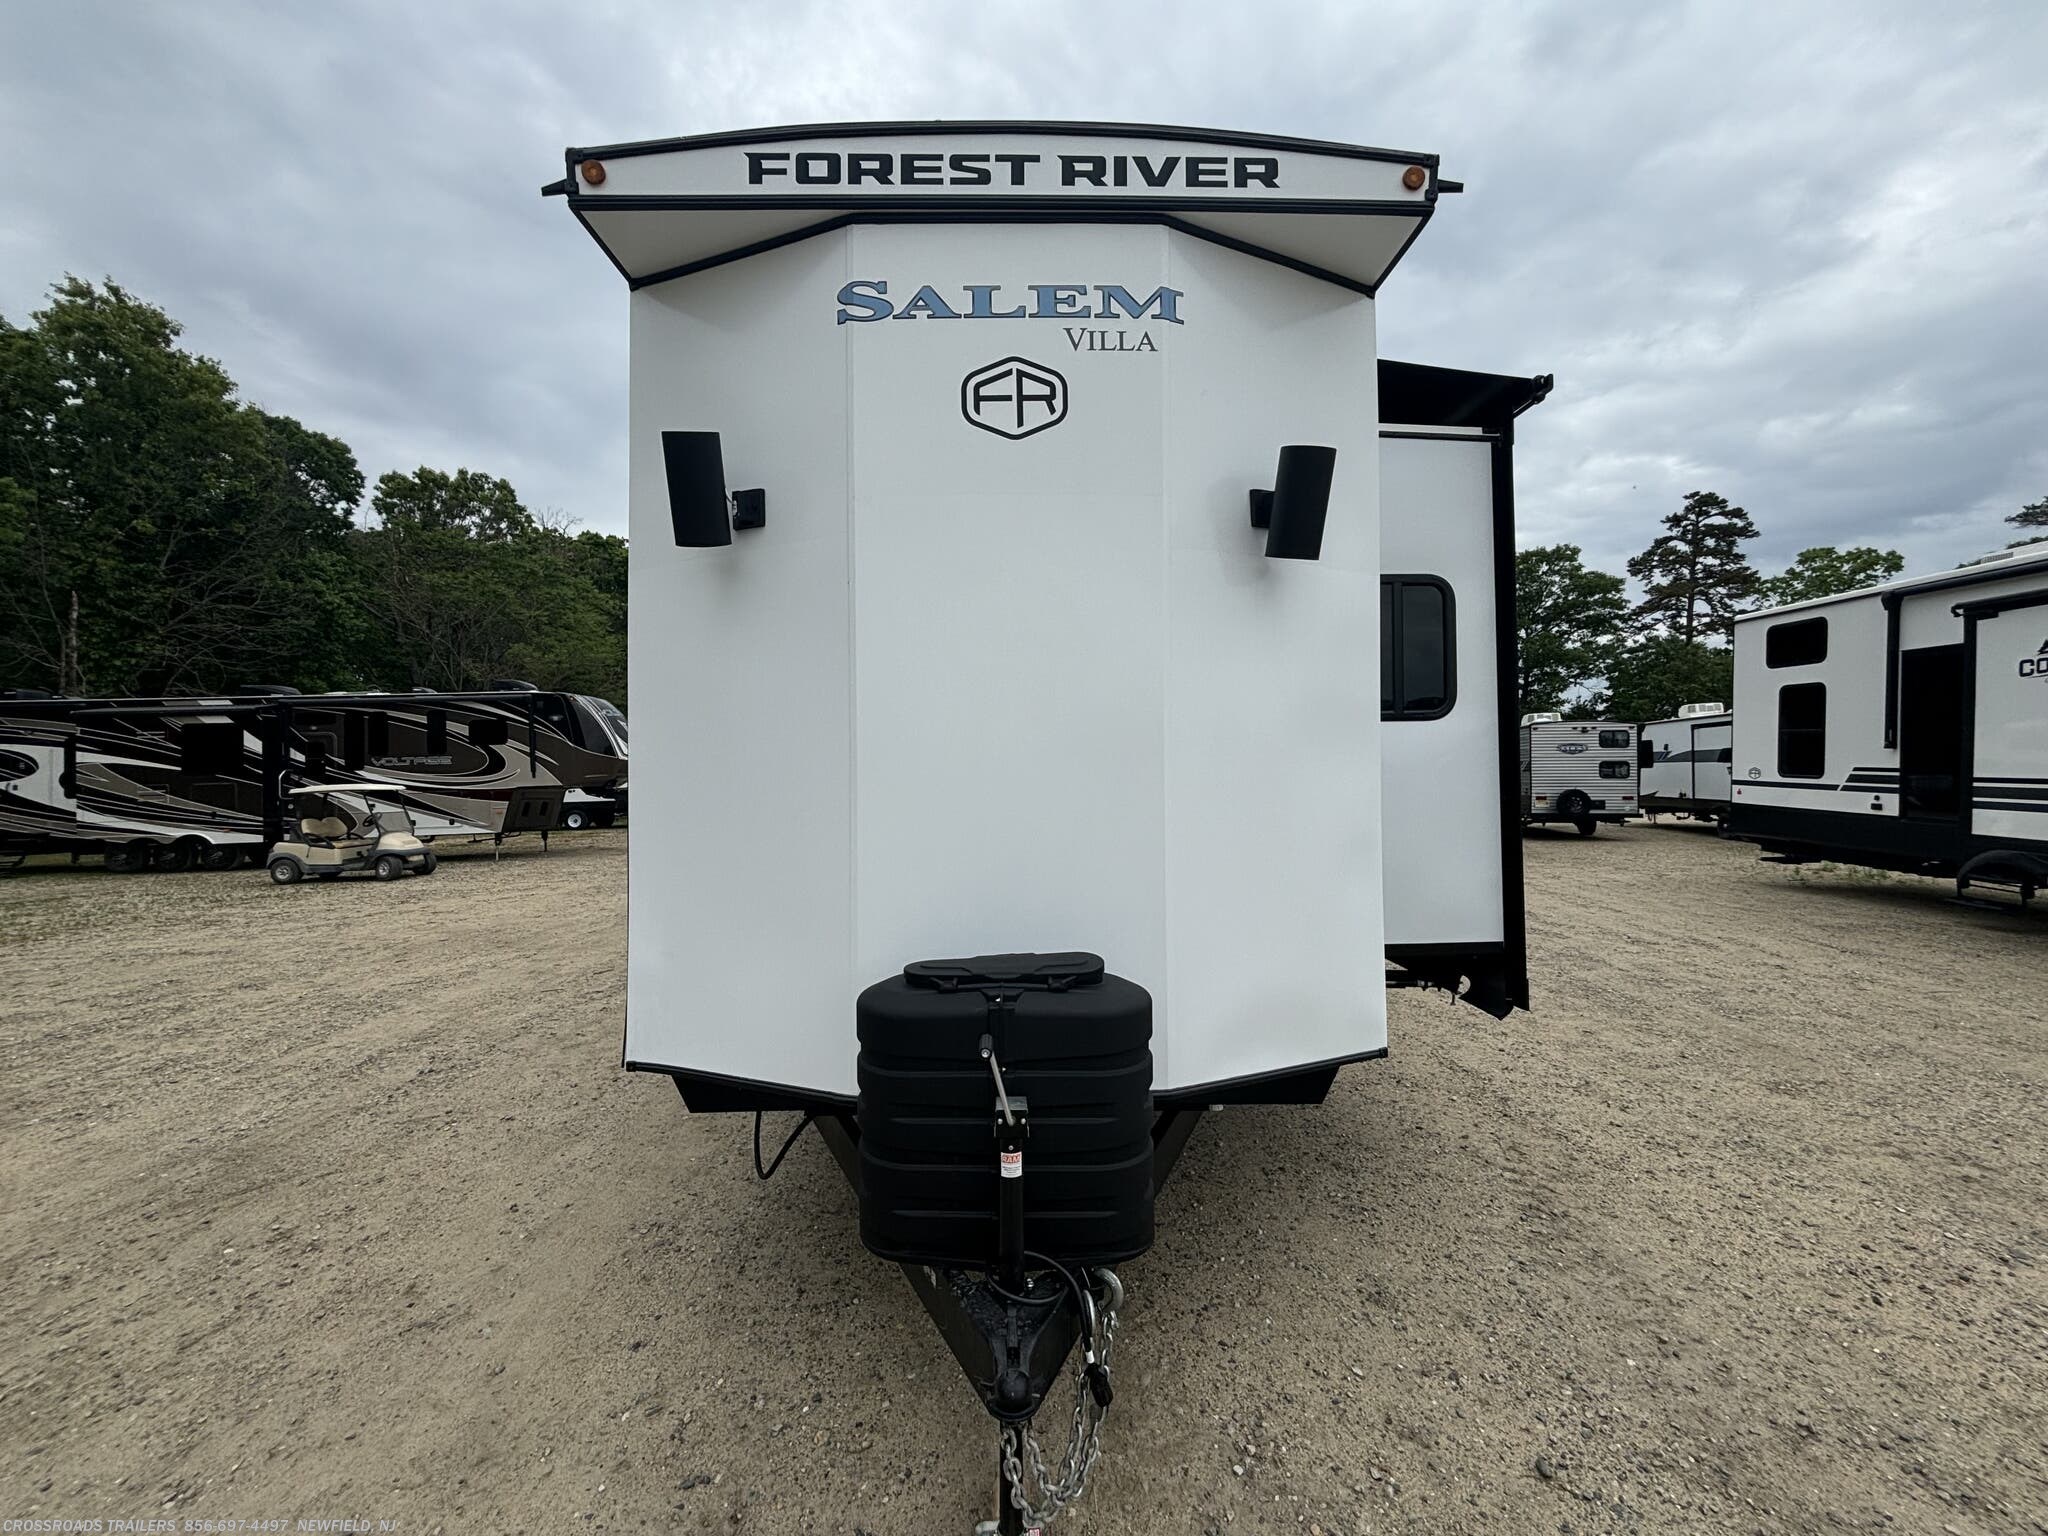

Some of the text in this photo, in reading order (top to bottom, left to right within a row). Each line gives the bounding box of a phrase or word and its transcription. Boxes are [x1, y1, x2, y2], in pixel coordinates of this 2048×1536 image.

[744, 152, 1279, 189] FOREST RIVER
[837, 281, 1184, 325] SALEM
[1063, 328, 1158, 352] VILLA
